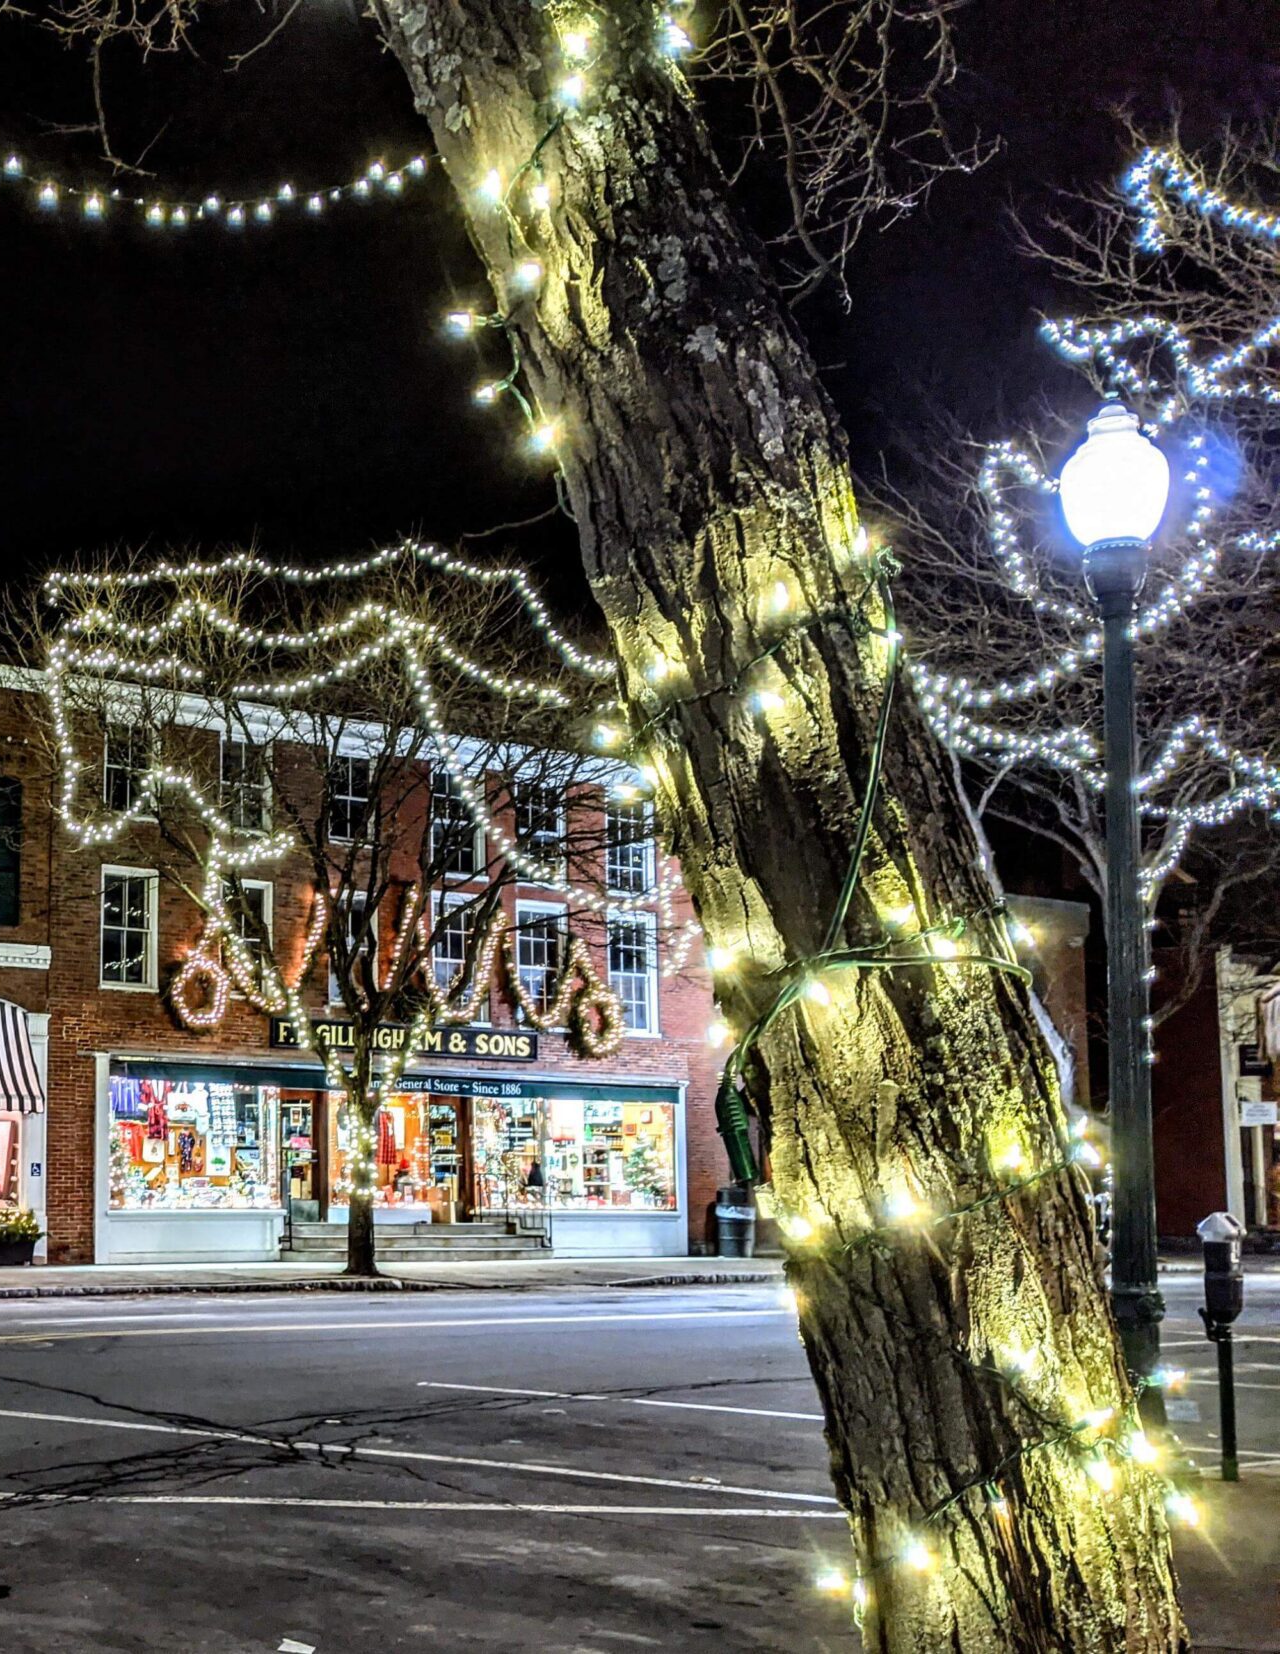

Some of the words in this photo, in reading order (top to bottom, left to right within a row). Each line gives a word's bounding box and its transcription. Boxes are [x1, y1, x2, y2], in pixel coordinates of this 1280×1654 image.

[448, 1035, 467, 1052] &
[475, 1034, 531, 1057] SONS
[395, 1077, 432, 1091] General
[434, 1079, 460, 1092] Store
[472, 1080, 499, 1095] Since
[501, 1082, 522, 1096] 1886
